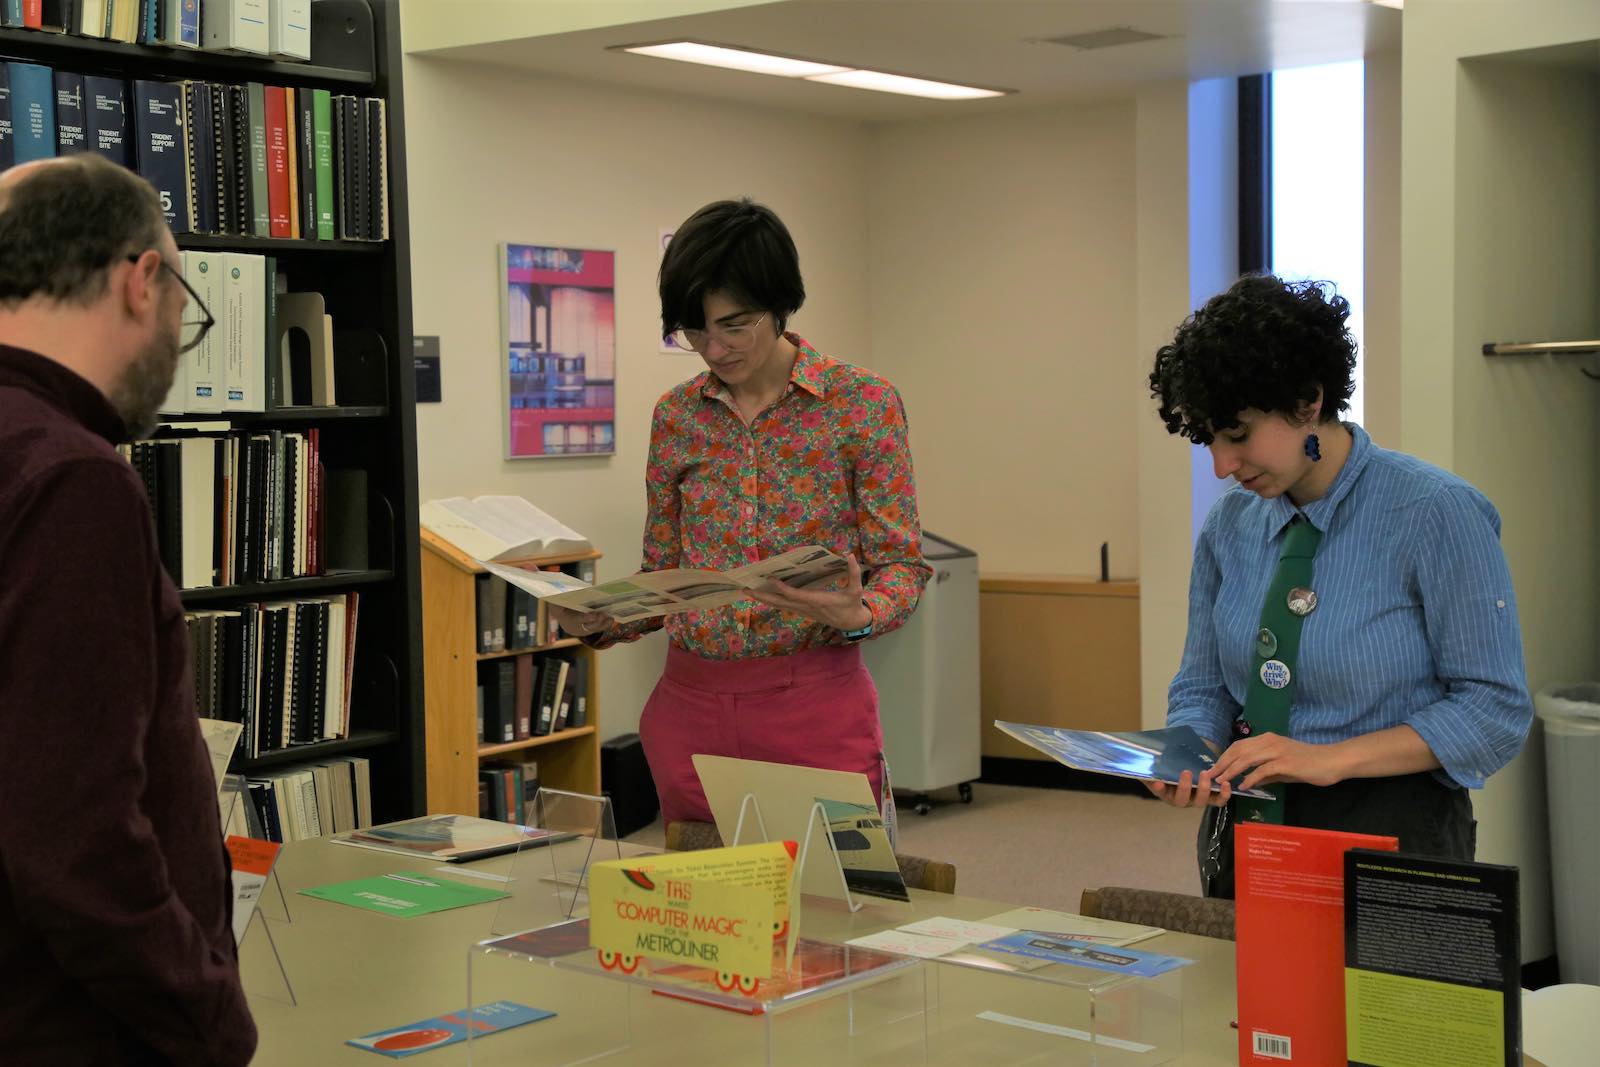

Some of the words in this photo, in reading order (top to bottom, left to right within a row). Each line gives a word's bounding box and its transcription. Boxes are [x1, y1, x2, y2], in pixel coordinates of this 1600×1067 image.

[60, 125, 82, 133] TRIDENT
[98, 129, 120, 137] TRIDENT
[60, 132, 84, 141] SUPPORT
[99, 136, 122, 144] SUPPORT
[151, 132, 172, 140] TRIDENT
[60, 138, 74, 146] SITE
[160, 191, 172, 211] 5
[1263, 669, 1288, 679] drive?
[1264, 678, 1288, 688] Why?
[636, 933, 720, 963] METROLINER
